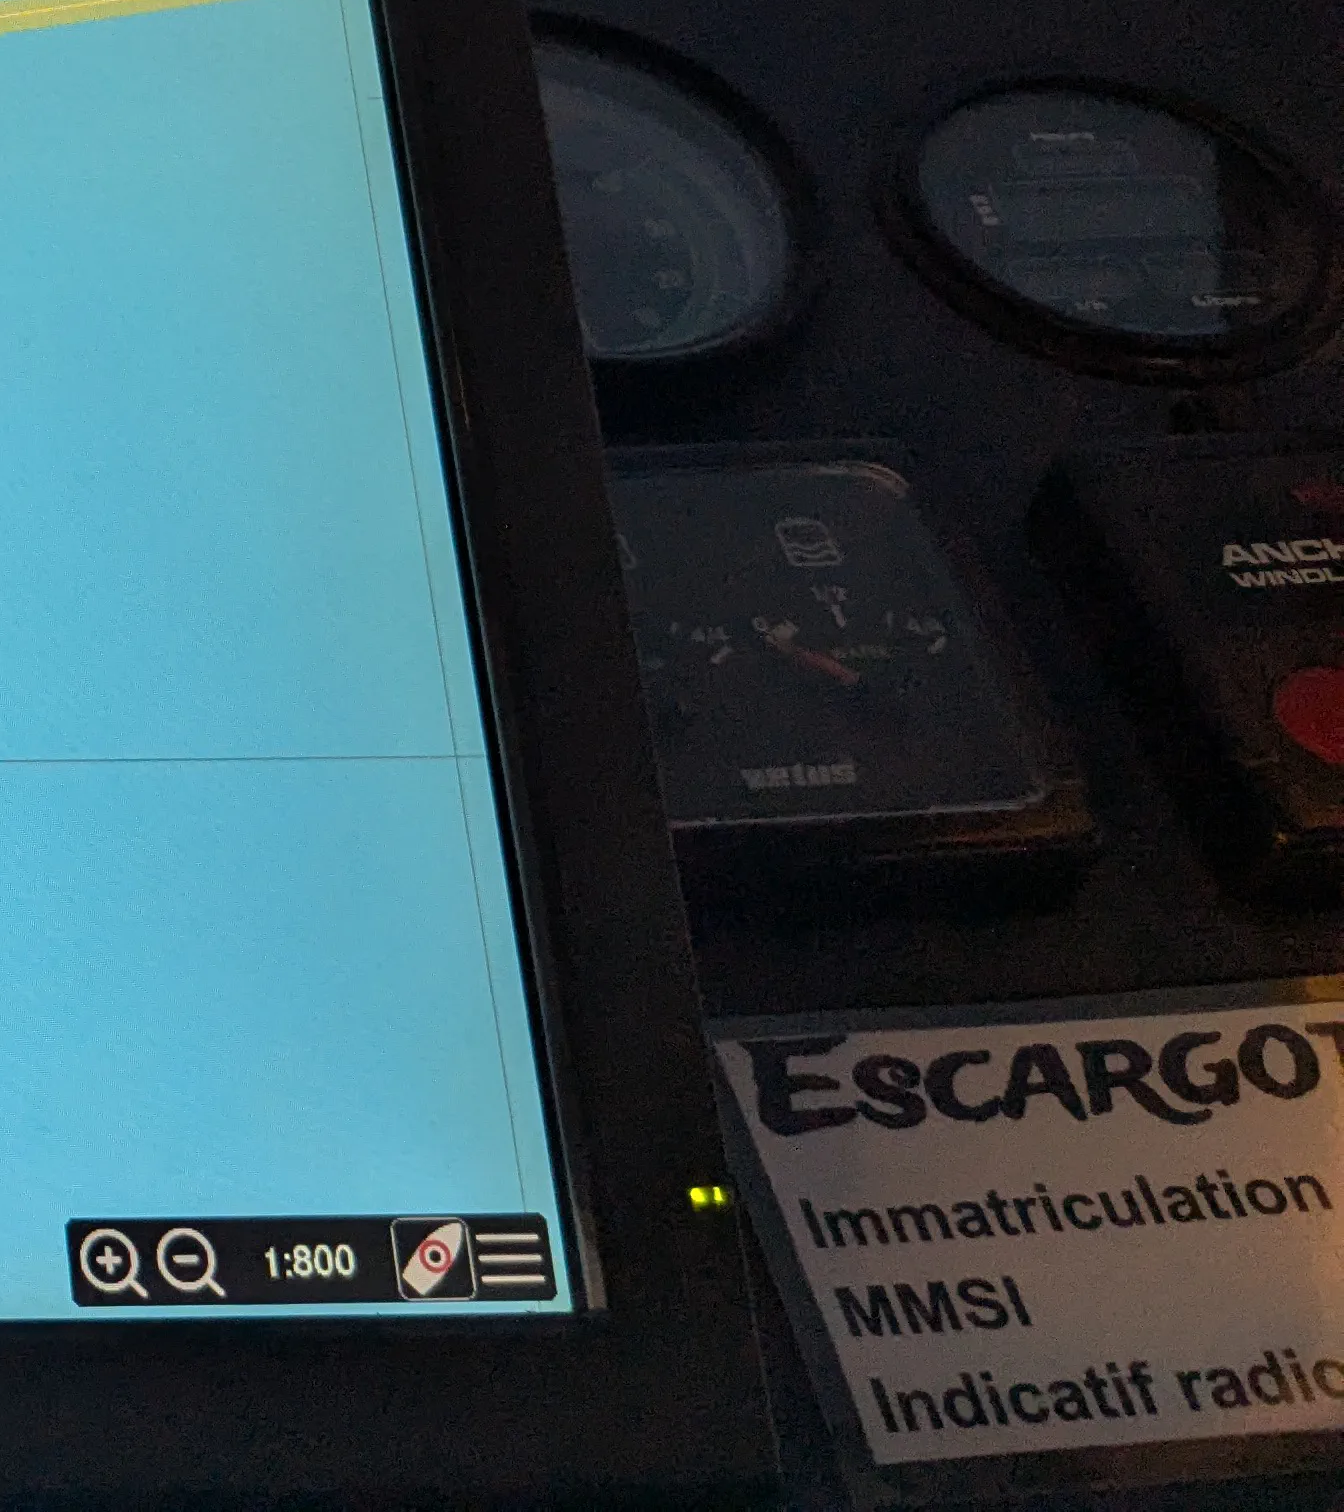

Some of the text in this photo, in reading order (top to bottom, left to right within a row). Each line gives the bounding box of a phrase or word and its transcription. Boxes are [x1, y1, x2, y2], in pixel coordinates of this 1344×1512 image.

[799, 1167, 1332, 1250] Immatriculation
[263, 1243, 357, 1279] 1:800
[834, 1274, 1033, 1338] MMSI
[870, 1346, 1344, 1433] Indicatif radio
